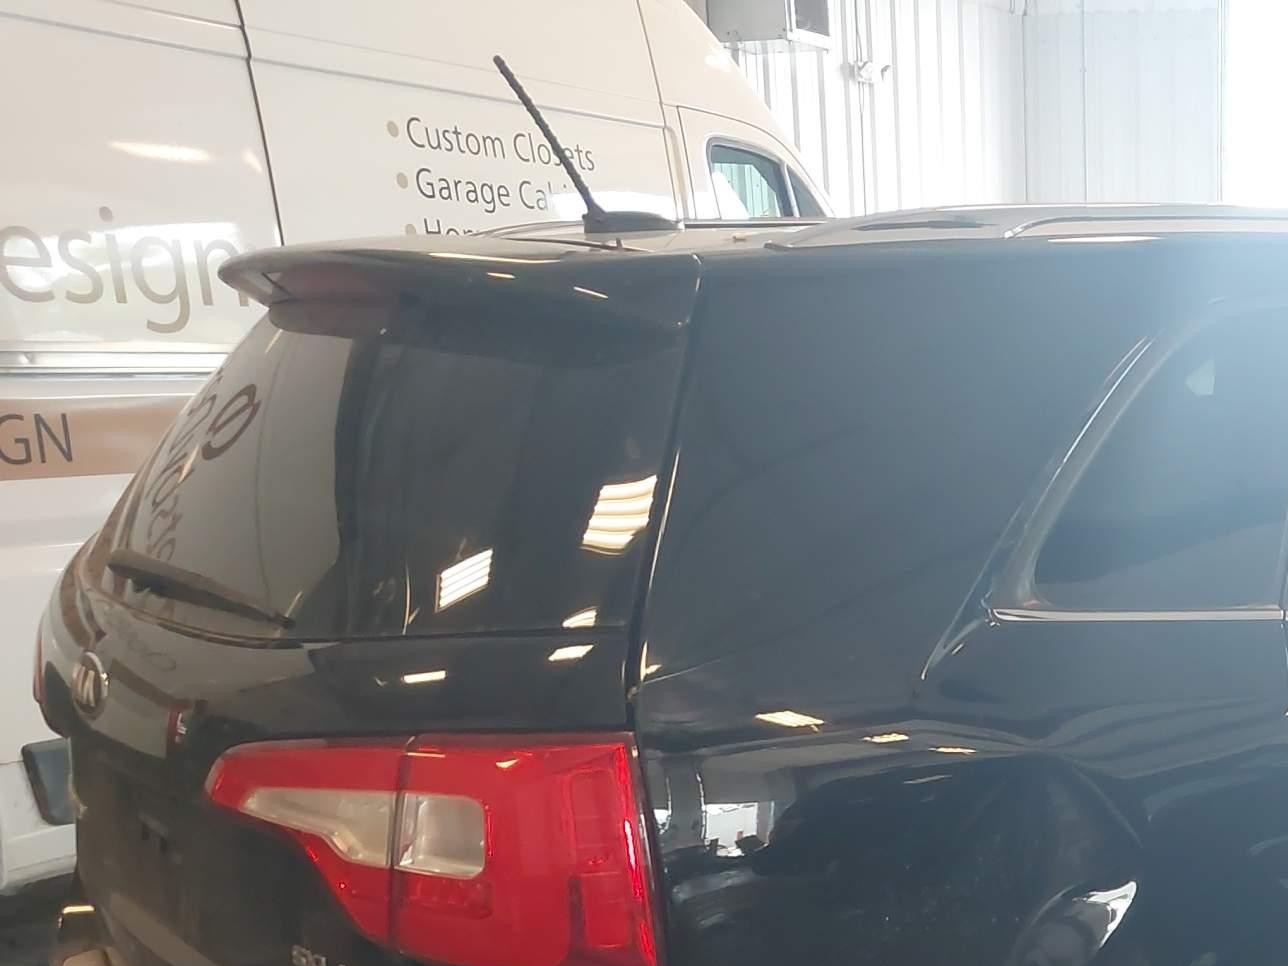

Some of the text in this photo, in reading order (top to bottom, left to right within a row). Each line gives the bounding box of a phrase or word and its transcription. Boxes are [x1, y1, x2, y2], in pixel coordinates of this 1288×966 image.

[406, 116, 595, 172] Custom Cloets
[415, 167, 511, 214] Garage
[0, 413, 73, 466] GN
